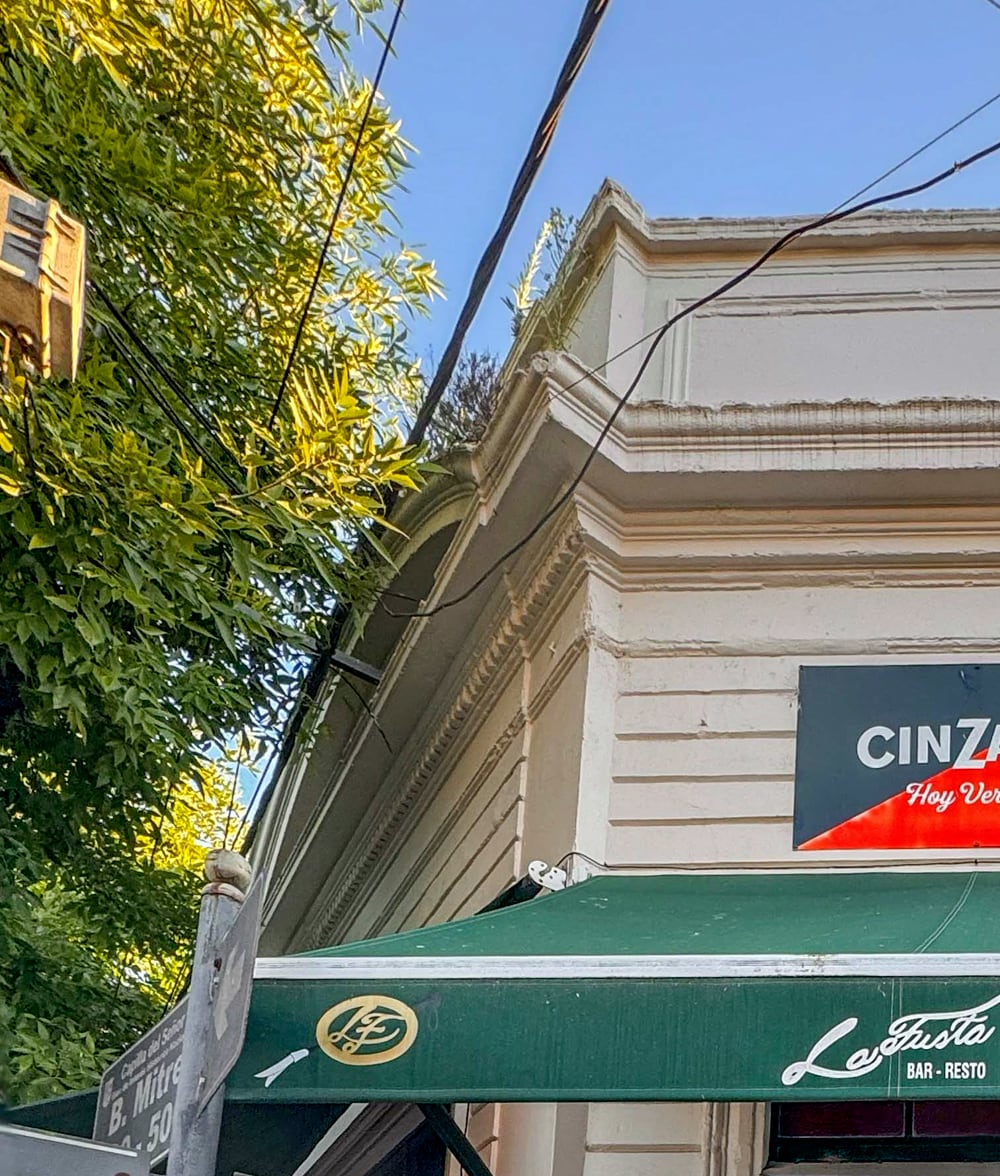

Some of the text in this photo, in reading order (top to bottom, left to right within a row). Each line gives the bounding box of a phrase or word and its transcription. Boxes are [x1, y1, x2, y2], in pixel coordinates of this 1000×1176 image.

[905, 782, 956, 812] Hoy
[781, 1017, 883, 1085] La
[907, 1062, 933, 1079] BAR
[945, 1062, 986, 1079] RESTO
[109, 1098, 127, 1136] B.
[133, 1054, 183, 1118] Mitre
[147, 1102, 173, 1152] 50
